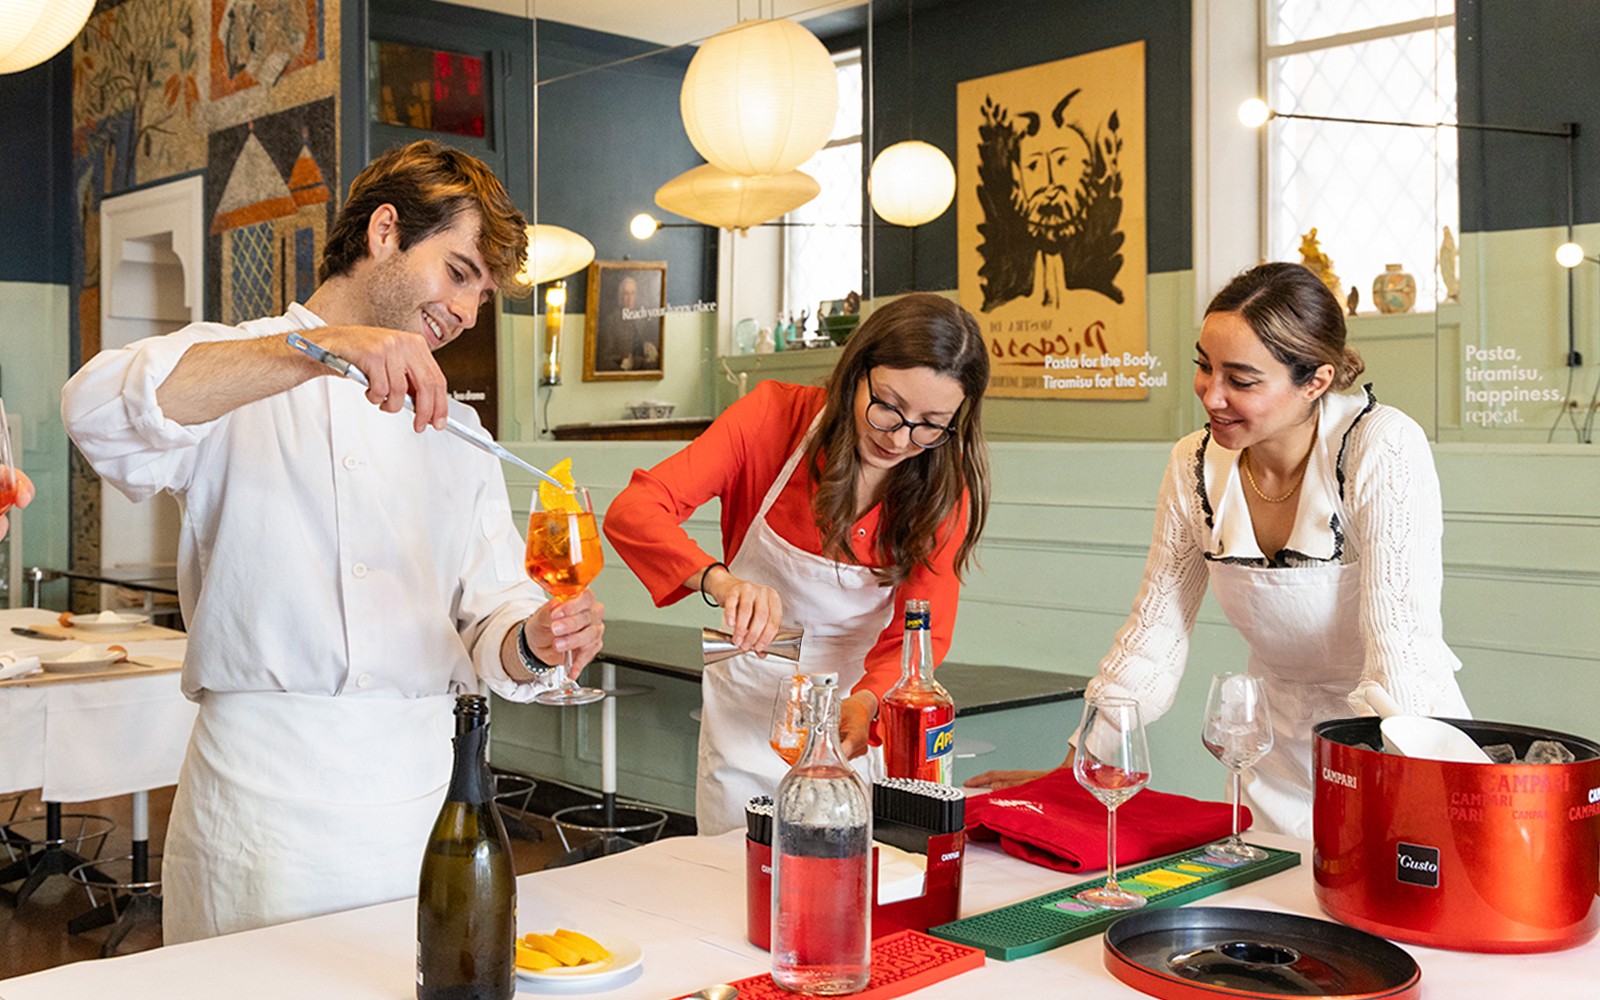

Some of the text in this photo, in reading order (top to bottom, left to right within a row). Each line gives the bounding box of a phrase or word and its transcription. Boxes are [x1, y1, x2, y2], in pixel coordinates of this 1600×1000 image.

[622, 306, 646, 320] Reach
[647, 307, 666, 321] your
[1044, 354, 1079, 370] Pasta
[1080, 354, 1098, 368] for
[1101, 353, 1121, 368] the
[1465, 345, 1522, 361] Pasta,
[1042, 374, 1093, 389] Tiramisu
[1095, 374, 1113, 388] for
[1115, 373, 1136, 387] the
[1138, 371, 1167, 387] Soul
[1465, 365, 1543, 382] tiramisu,
[1465, 385, 1565, 407] happiness,
[1466, 408, 1524, 427] repeat.
[1322, 766, 1358, 790] CAMPARI
